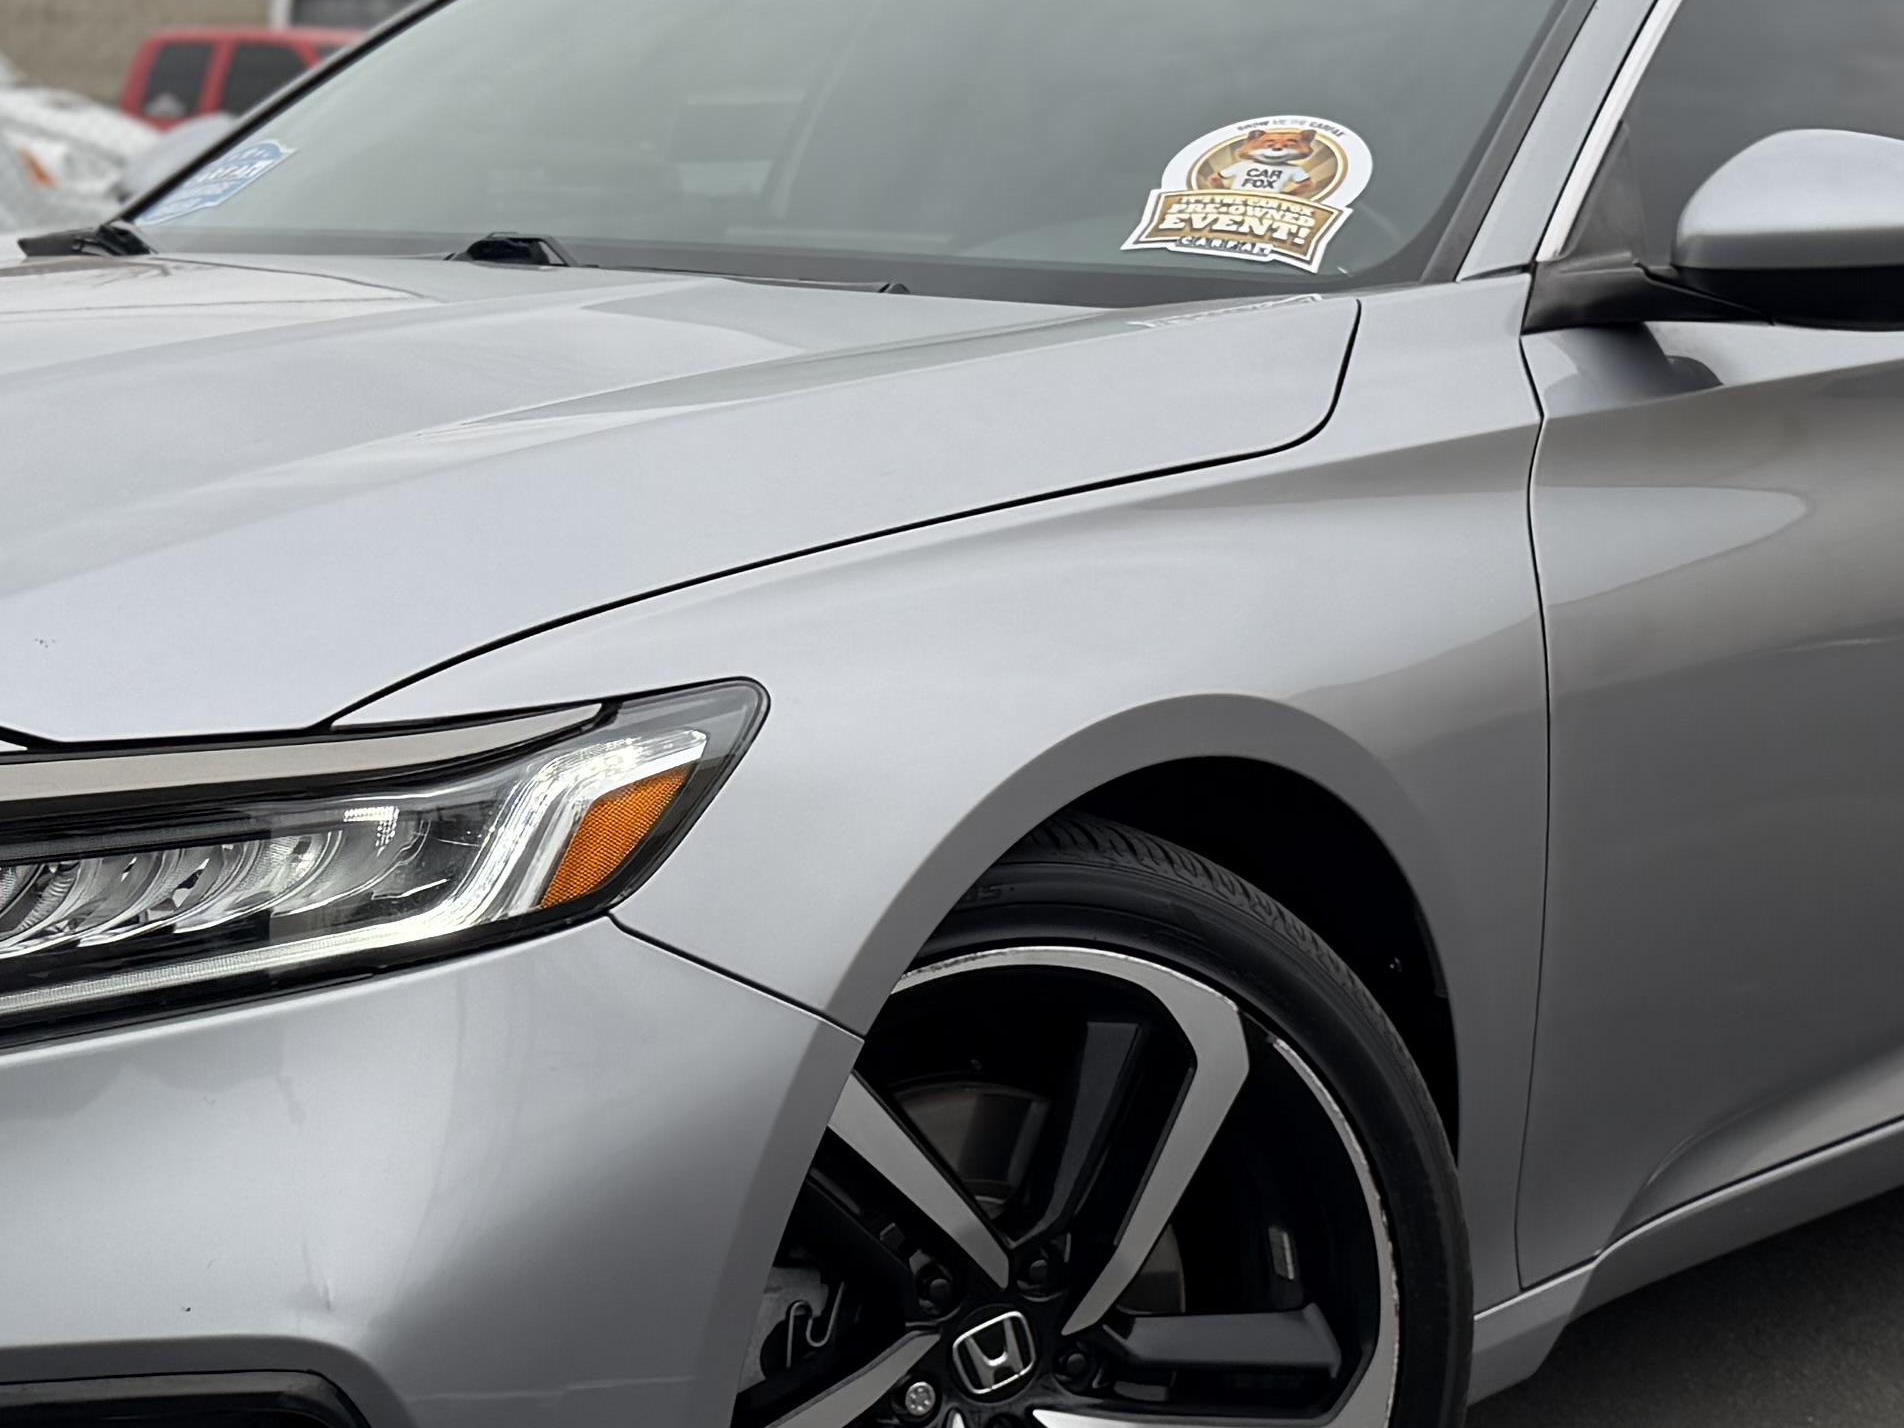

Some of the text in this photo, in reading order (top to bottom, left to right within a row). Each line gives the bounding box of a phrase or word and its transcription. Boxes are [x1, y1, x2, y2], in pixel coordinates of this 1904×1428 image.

[1245, 168, 1283, 180] CAR
[1241, 178, 1278, 189] FOX
[1158, 213, 1311, 244] EVENT!
